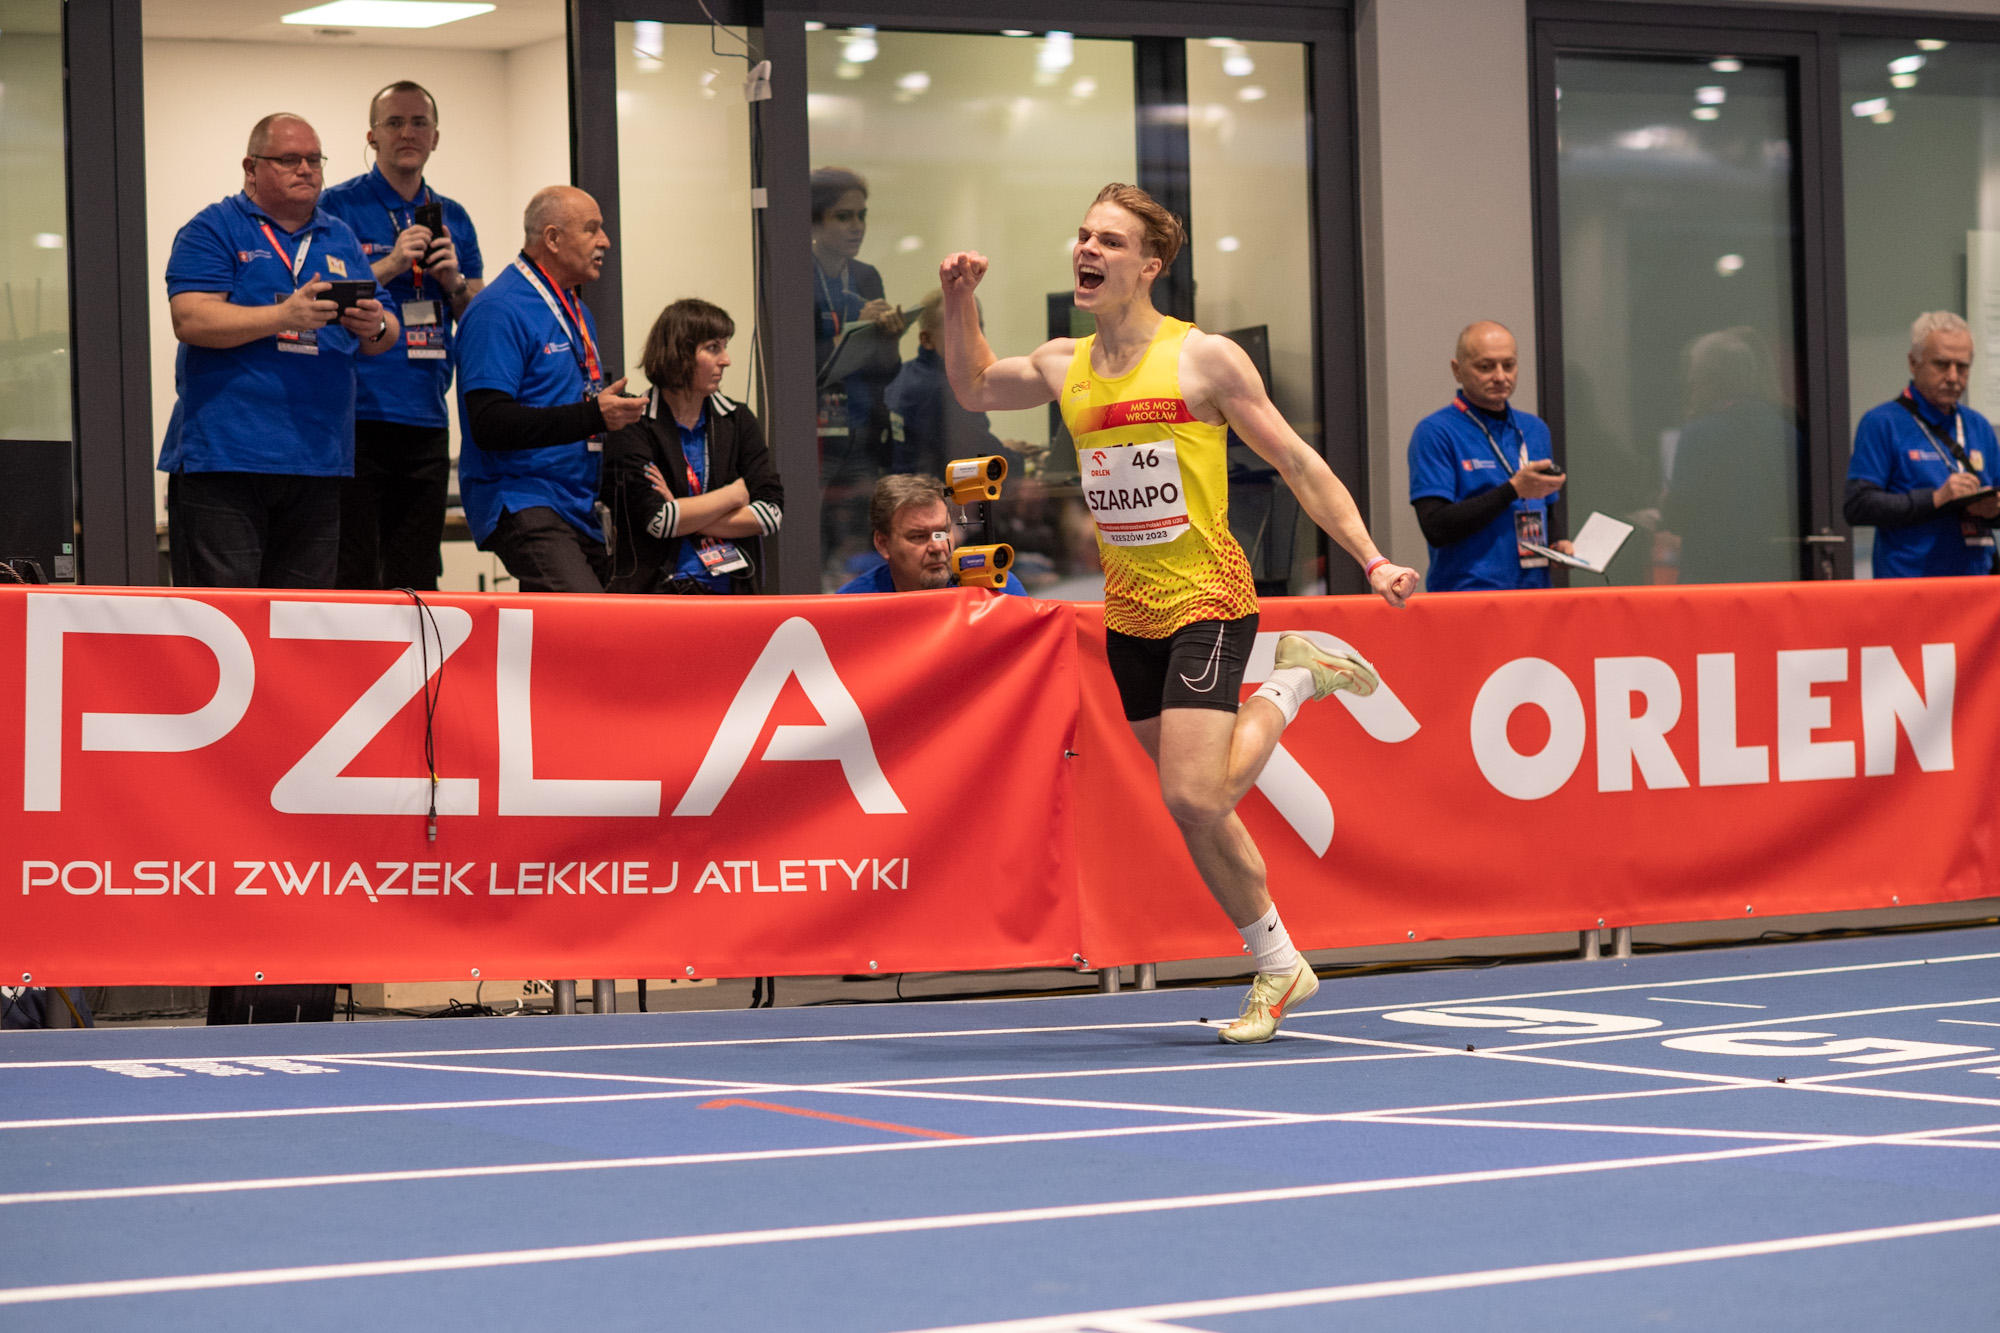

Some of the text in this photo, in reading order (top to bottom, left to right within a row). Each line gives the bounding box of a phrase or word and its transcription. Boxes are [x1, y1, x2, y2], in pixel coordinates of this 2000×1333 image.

[1125, 411, 1177, 422] WROCŁAW
[1130, 401, 1177, 412] MKS MOS
[1131, 448, 1160, 470] 46
[1090, 469, 1111, 477] ORLEN
[1088, 482, 1178, 511] SZARAPO
[1110, 530, 1168, 542] RZESZÓW 2023
[23, 592, 908, 817] PZLA
[1470, 643, 1956, 800] ORLEN
[22, 857, 909, 903] POLSKI ZWIĄZEK LEKKIEJ ATLETYKI
[1661, 1031, 1995, 1064] 5
